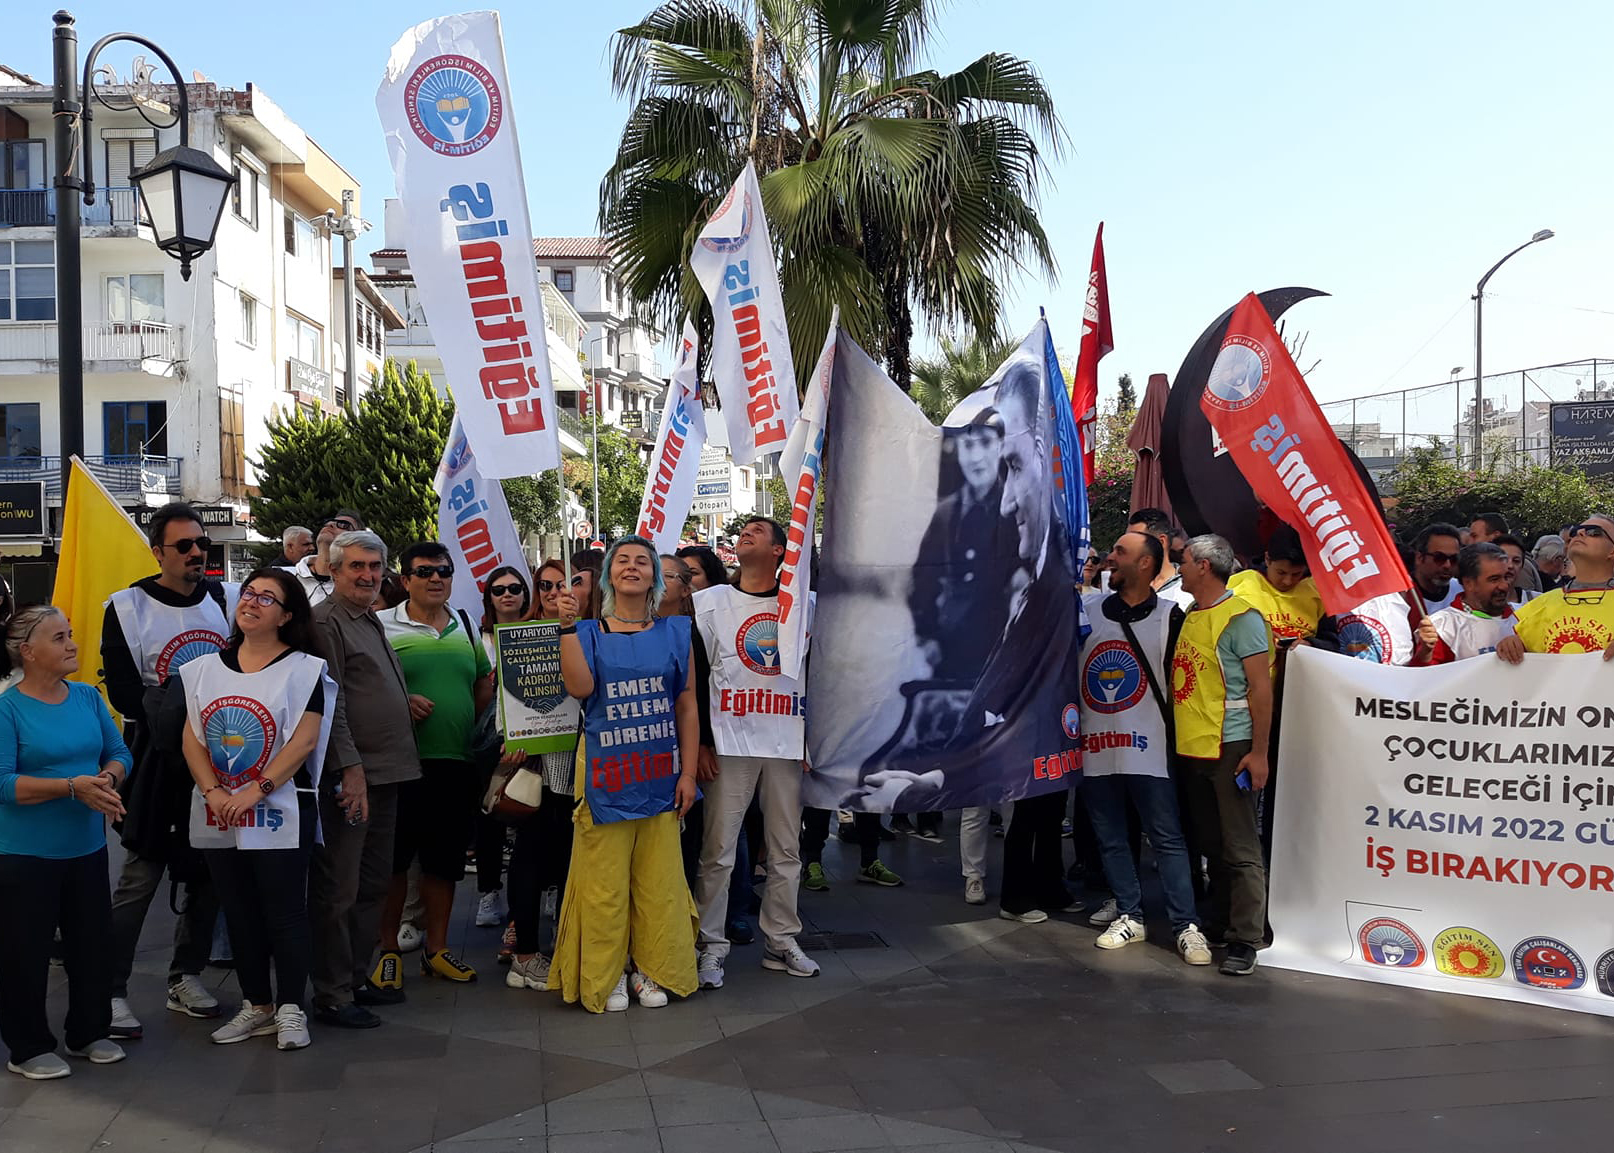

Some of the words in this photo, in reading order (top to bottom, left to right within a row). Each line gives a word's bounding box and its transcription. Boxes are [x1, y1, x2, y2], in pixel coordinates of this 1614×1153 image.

[202, 510, 230, 523] WATCH
[699, 500, 728, 510] Otopark
[510, 626, 558, 639] UYARIYORU
[517, 672, 565, 687] KADROYA
[606, 675, 665, 699] EMEK
[606, 697, 671, 721] EYLEM
[1354, 696, 1566, 728] MESLEĞİMİZİN
[1383, 734, 1614, 768] ÇOCUKLARIMIZ
[591, 744, 681, 793] Eğitimi
[1403, 773, 1551, 803] GELECEĞİ
[1364, 805, 1380, 827] 2
[1388, 807, 1484, 837] KASIM
[1491, 816, 1565, 842] 2022
[1366, 836, 1396, 878] İŞ
[1406, 848, 1614, 893] BIRAKIYOR
[1437, 932, 1473, 951] EĞİTİM
